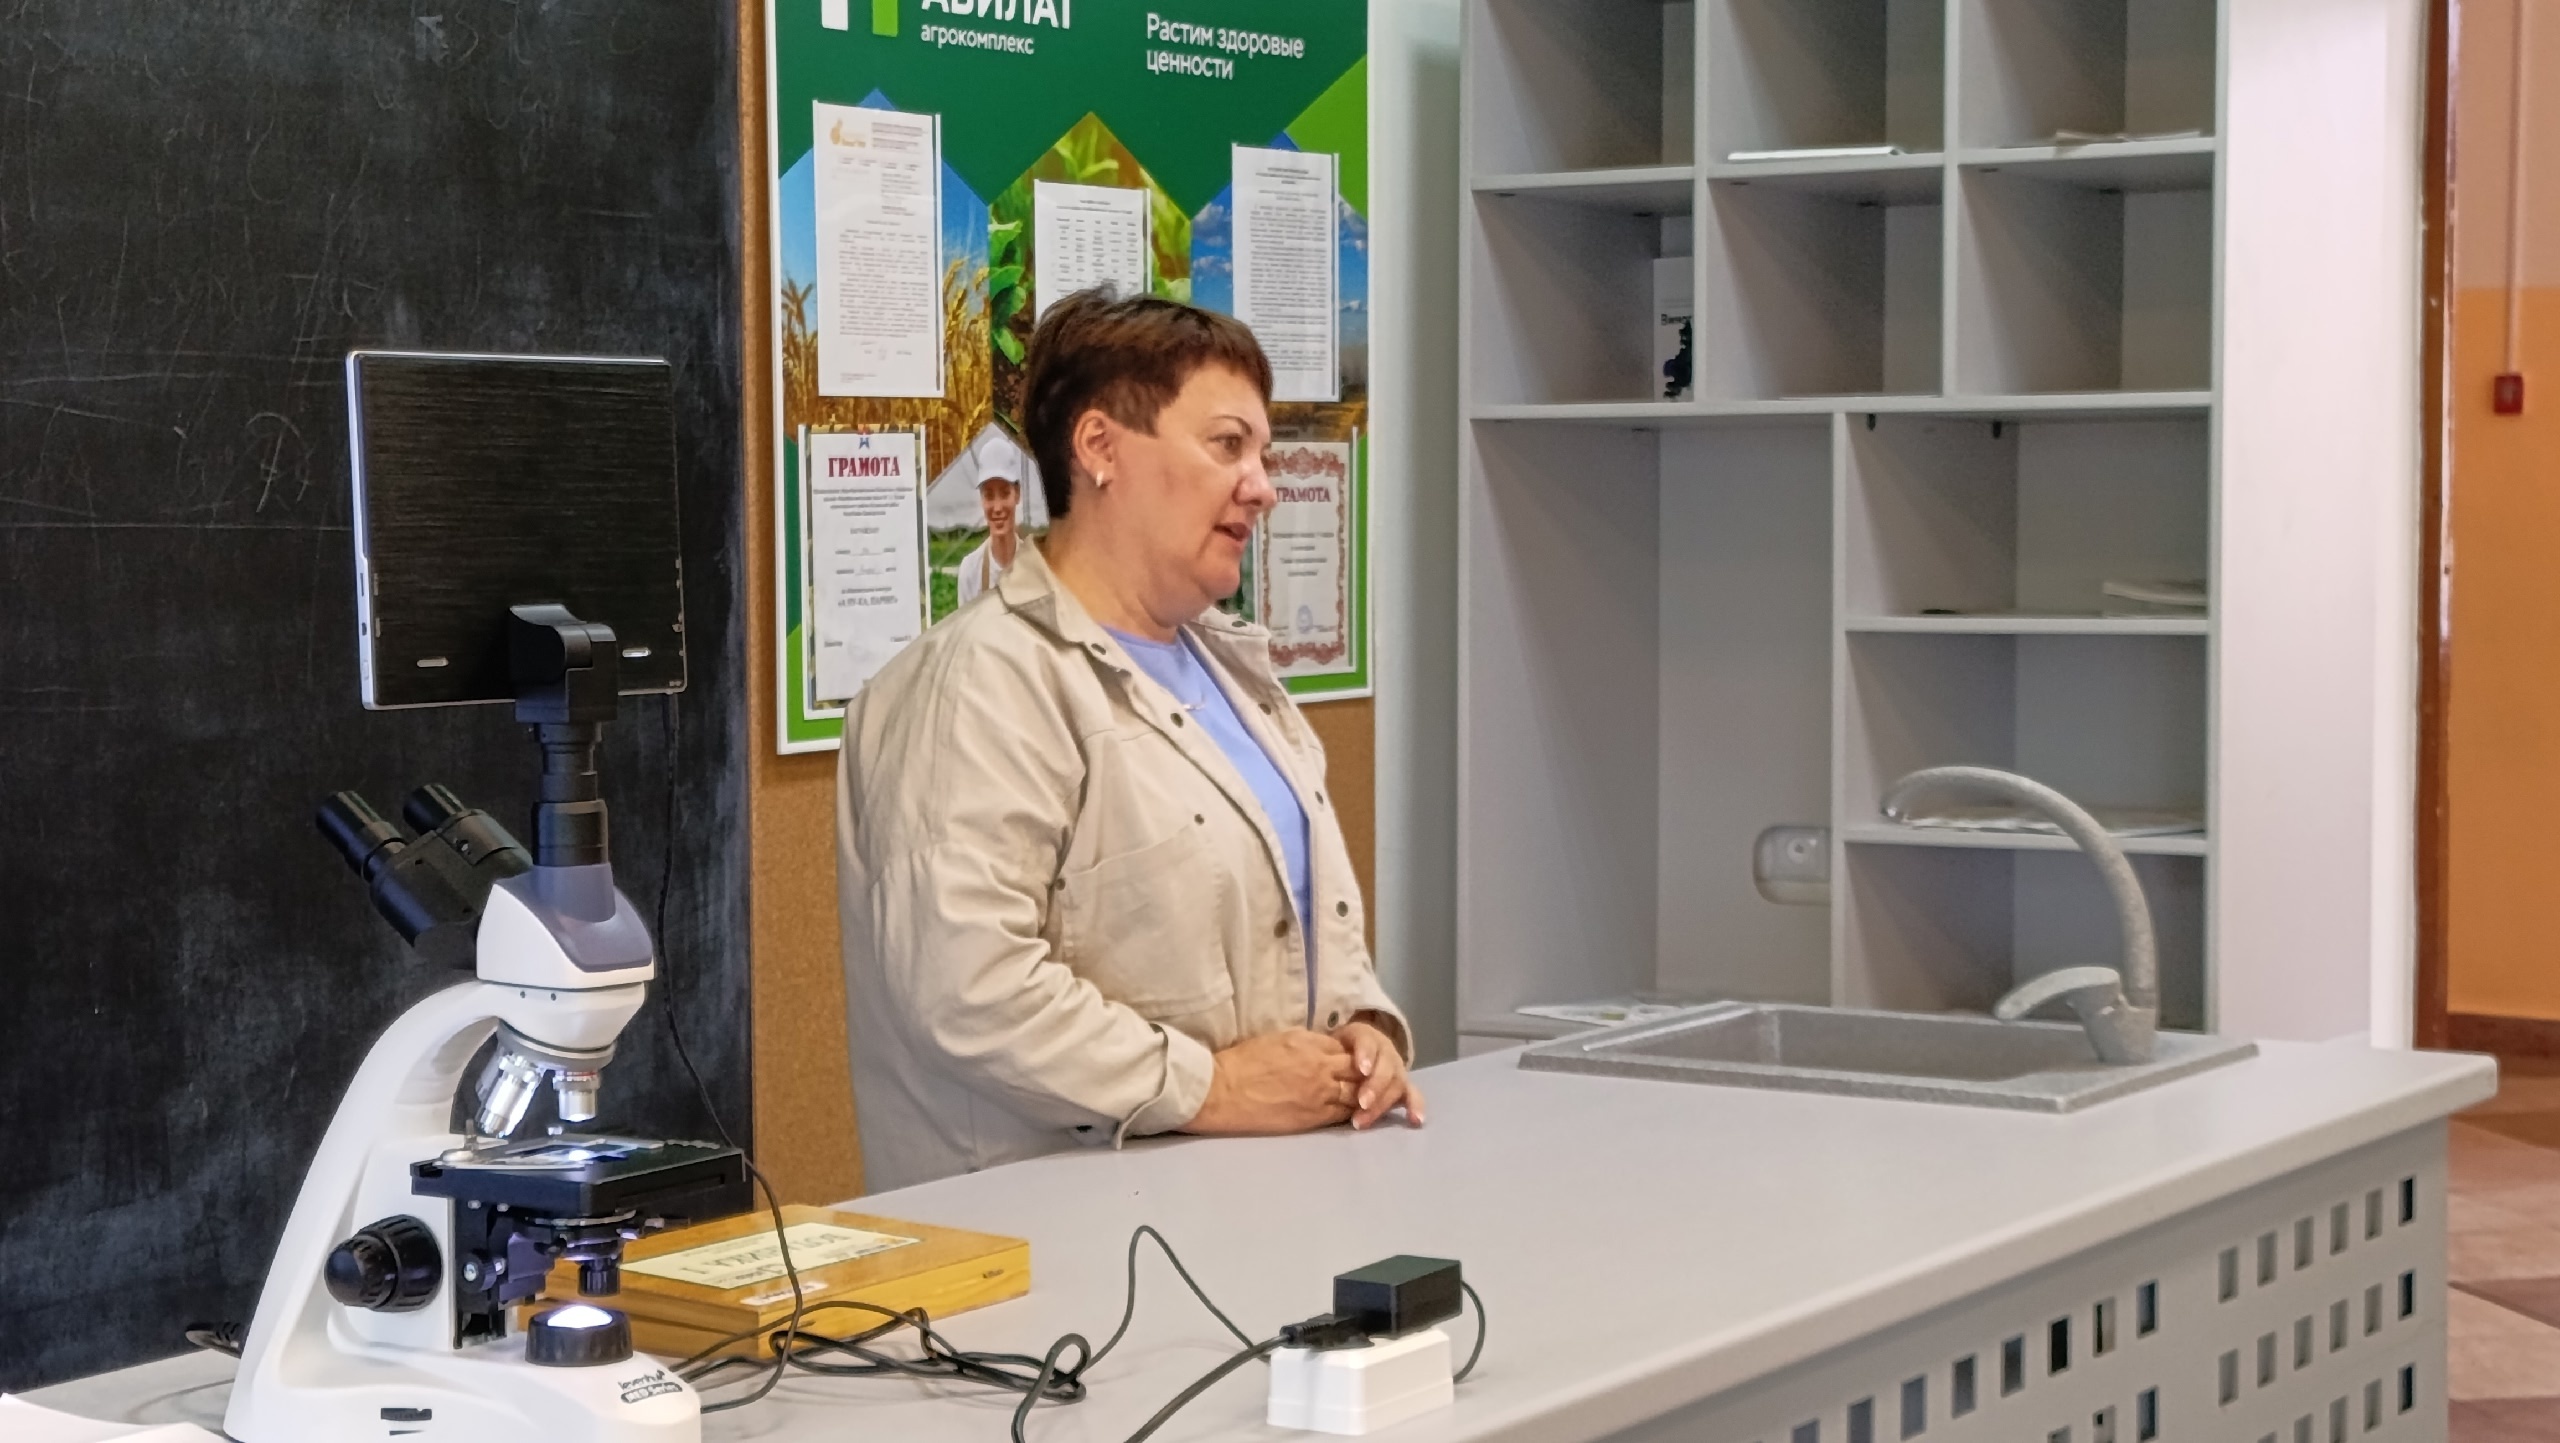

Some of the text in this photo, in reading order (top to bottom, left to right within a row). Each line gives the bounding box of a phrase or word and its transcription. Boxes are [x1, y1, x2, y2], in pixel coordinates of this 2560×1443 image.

[921, 24, 1035, 55] агрокомплекс
[1147, 13, 1304, 59] Растим здоровые
[1145, 47, 1235, 80] ценности
[828, 457, 900, 477] ГРАМОТА
[1276, 487, 1330, 503] ГРАМОТА
